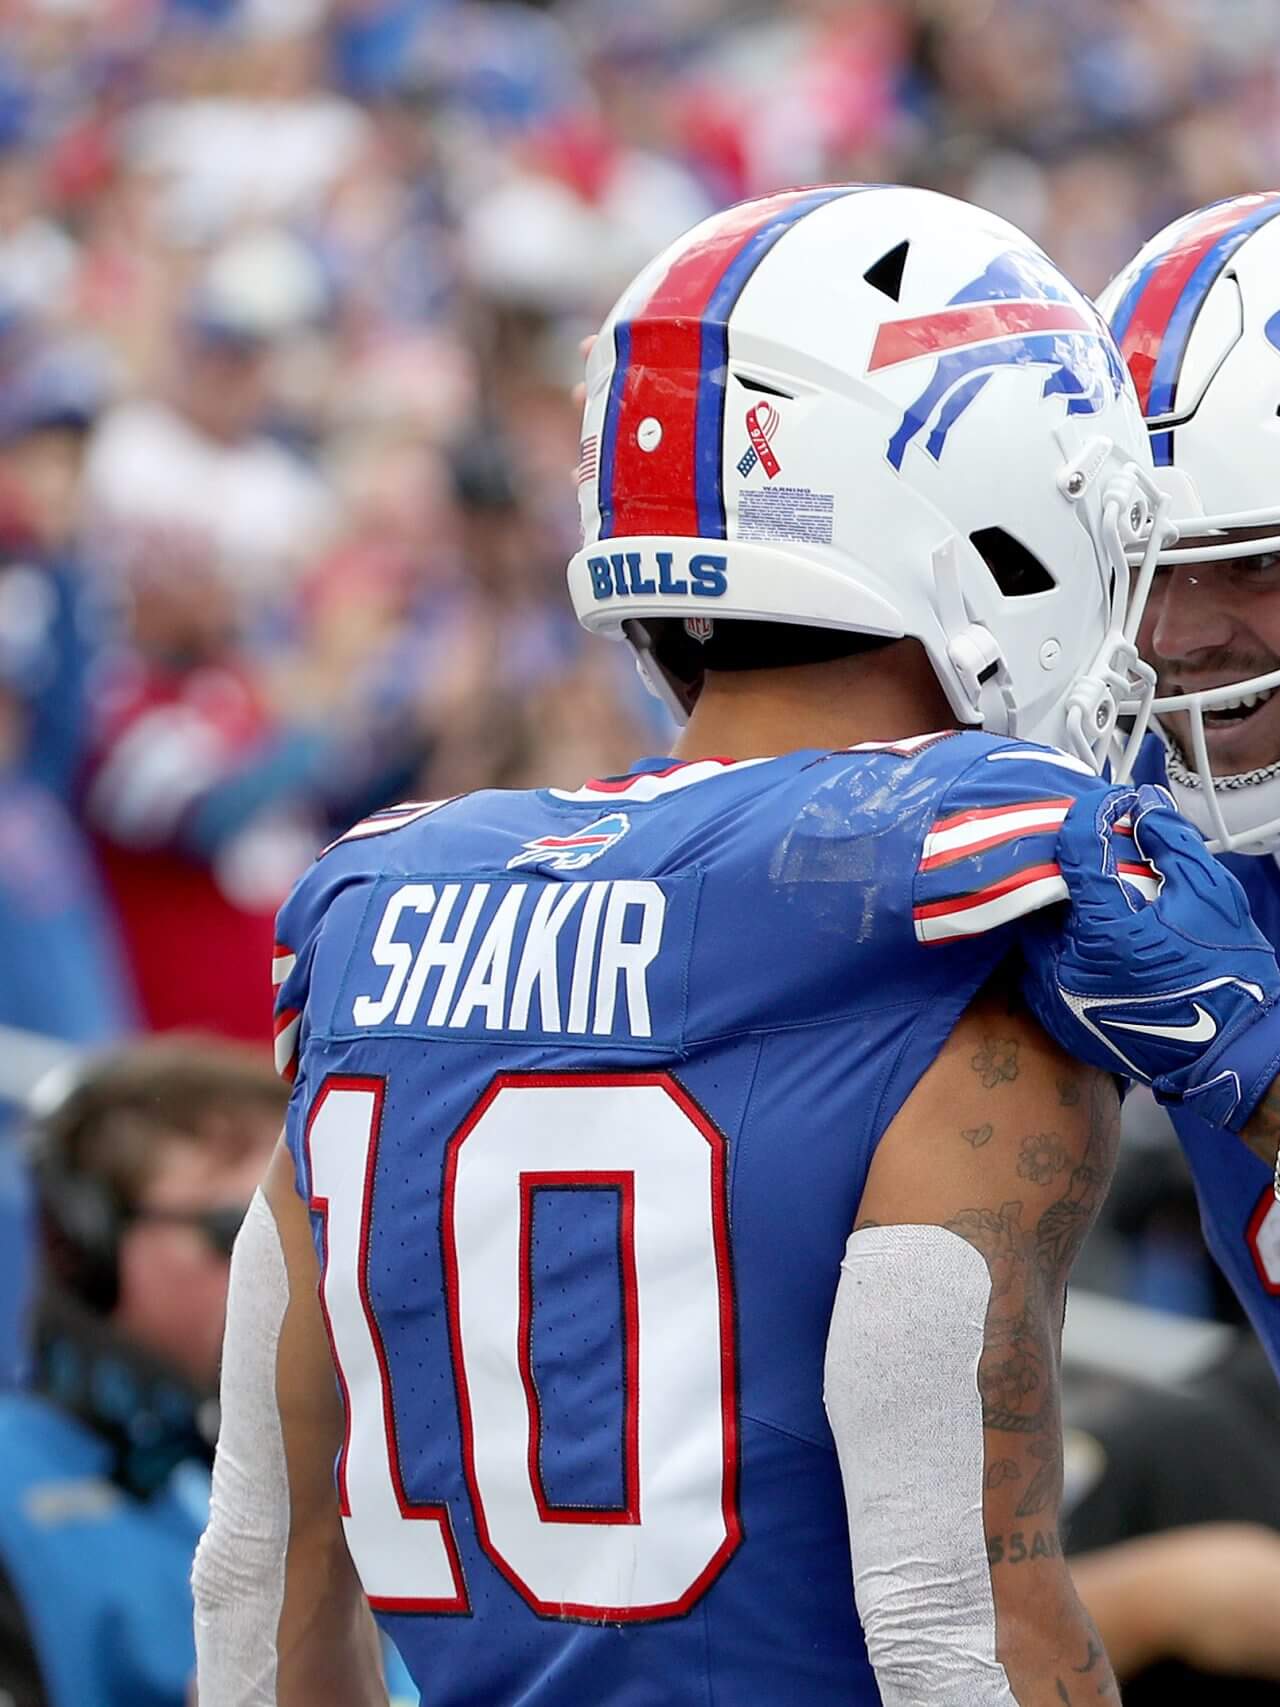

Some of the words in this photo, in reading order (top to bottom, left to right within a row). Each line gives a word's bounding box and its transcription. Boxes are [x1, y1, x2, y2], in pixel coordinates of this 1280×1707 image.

[750, 428, 769, 456] 9/11
[762, 485, 812, 494] WARNING
[587, 552, 728, 600] BILLS
[351, 879, 667, 1038] SHAKIR
[303, 1069, 746, 1627] 10
